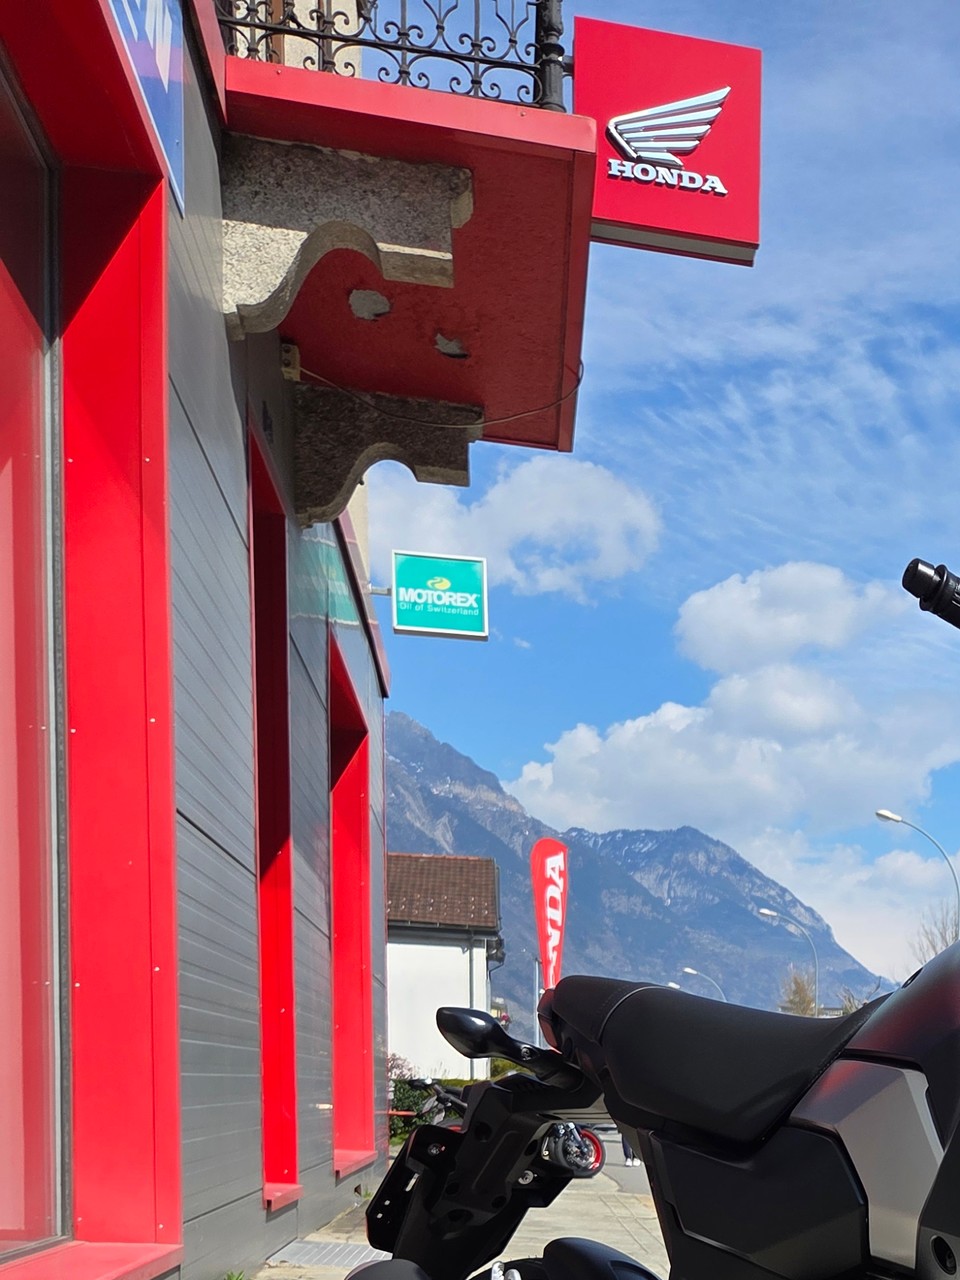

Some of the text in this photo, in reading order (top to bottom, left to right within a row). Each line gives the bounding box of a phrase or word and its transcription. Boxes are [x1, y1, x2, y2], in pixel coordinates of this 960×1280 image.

[608, 159, 728, 195] HONDA
[398, 587, 479, 608] MOTOREX
[400, 602, 479, 616] Oil of Switzerland
